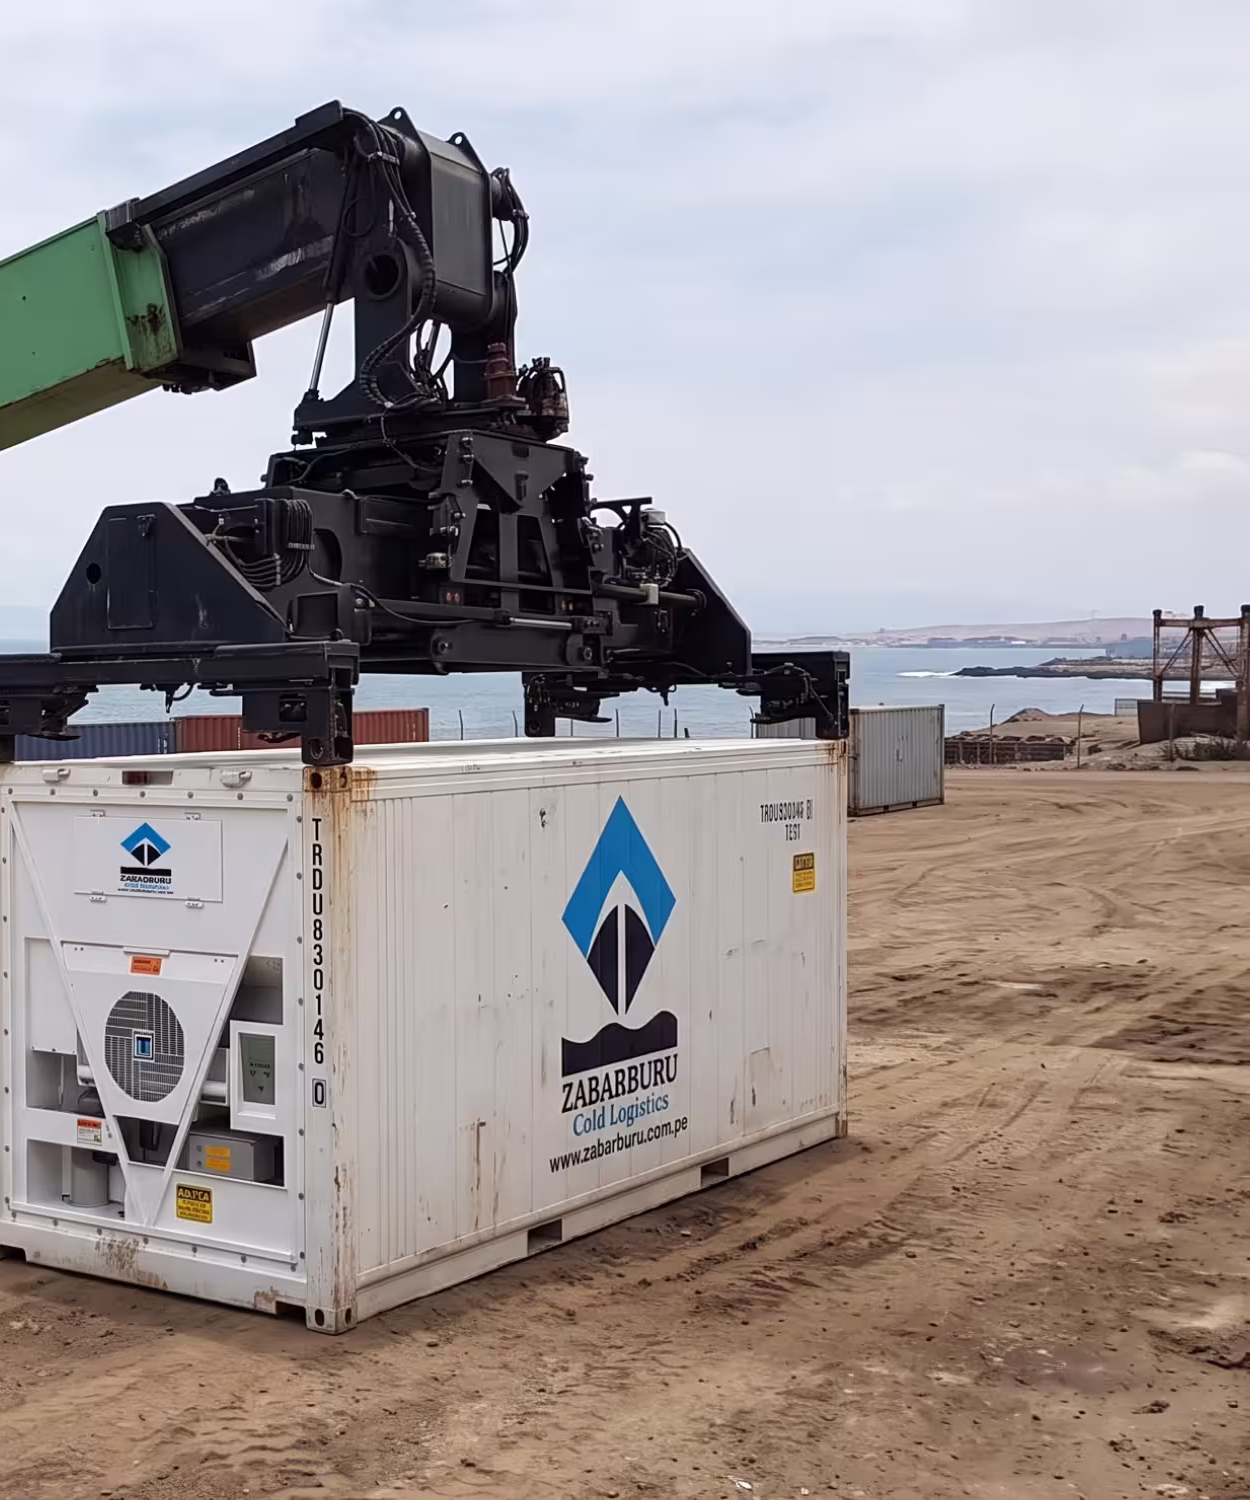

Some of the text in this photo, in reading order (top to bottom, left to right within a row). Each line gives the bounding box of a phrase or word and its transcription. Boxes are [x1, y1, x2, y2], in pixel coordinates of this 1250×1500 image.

[312, 818, 324, 1064] TRDU830146
[562, 1053, 678, 1113] ZABARBURU
[573, 1092, 669, 1136] Cold Logistics
[550, 1116, 688, 1173] www.zabarburu.com.pe
